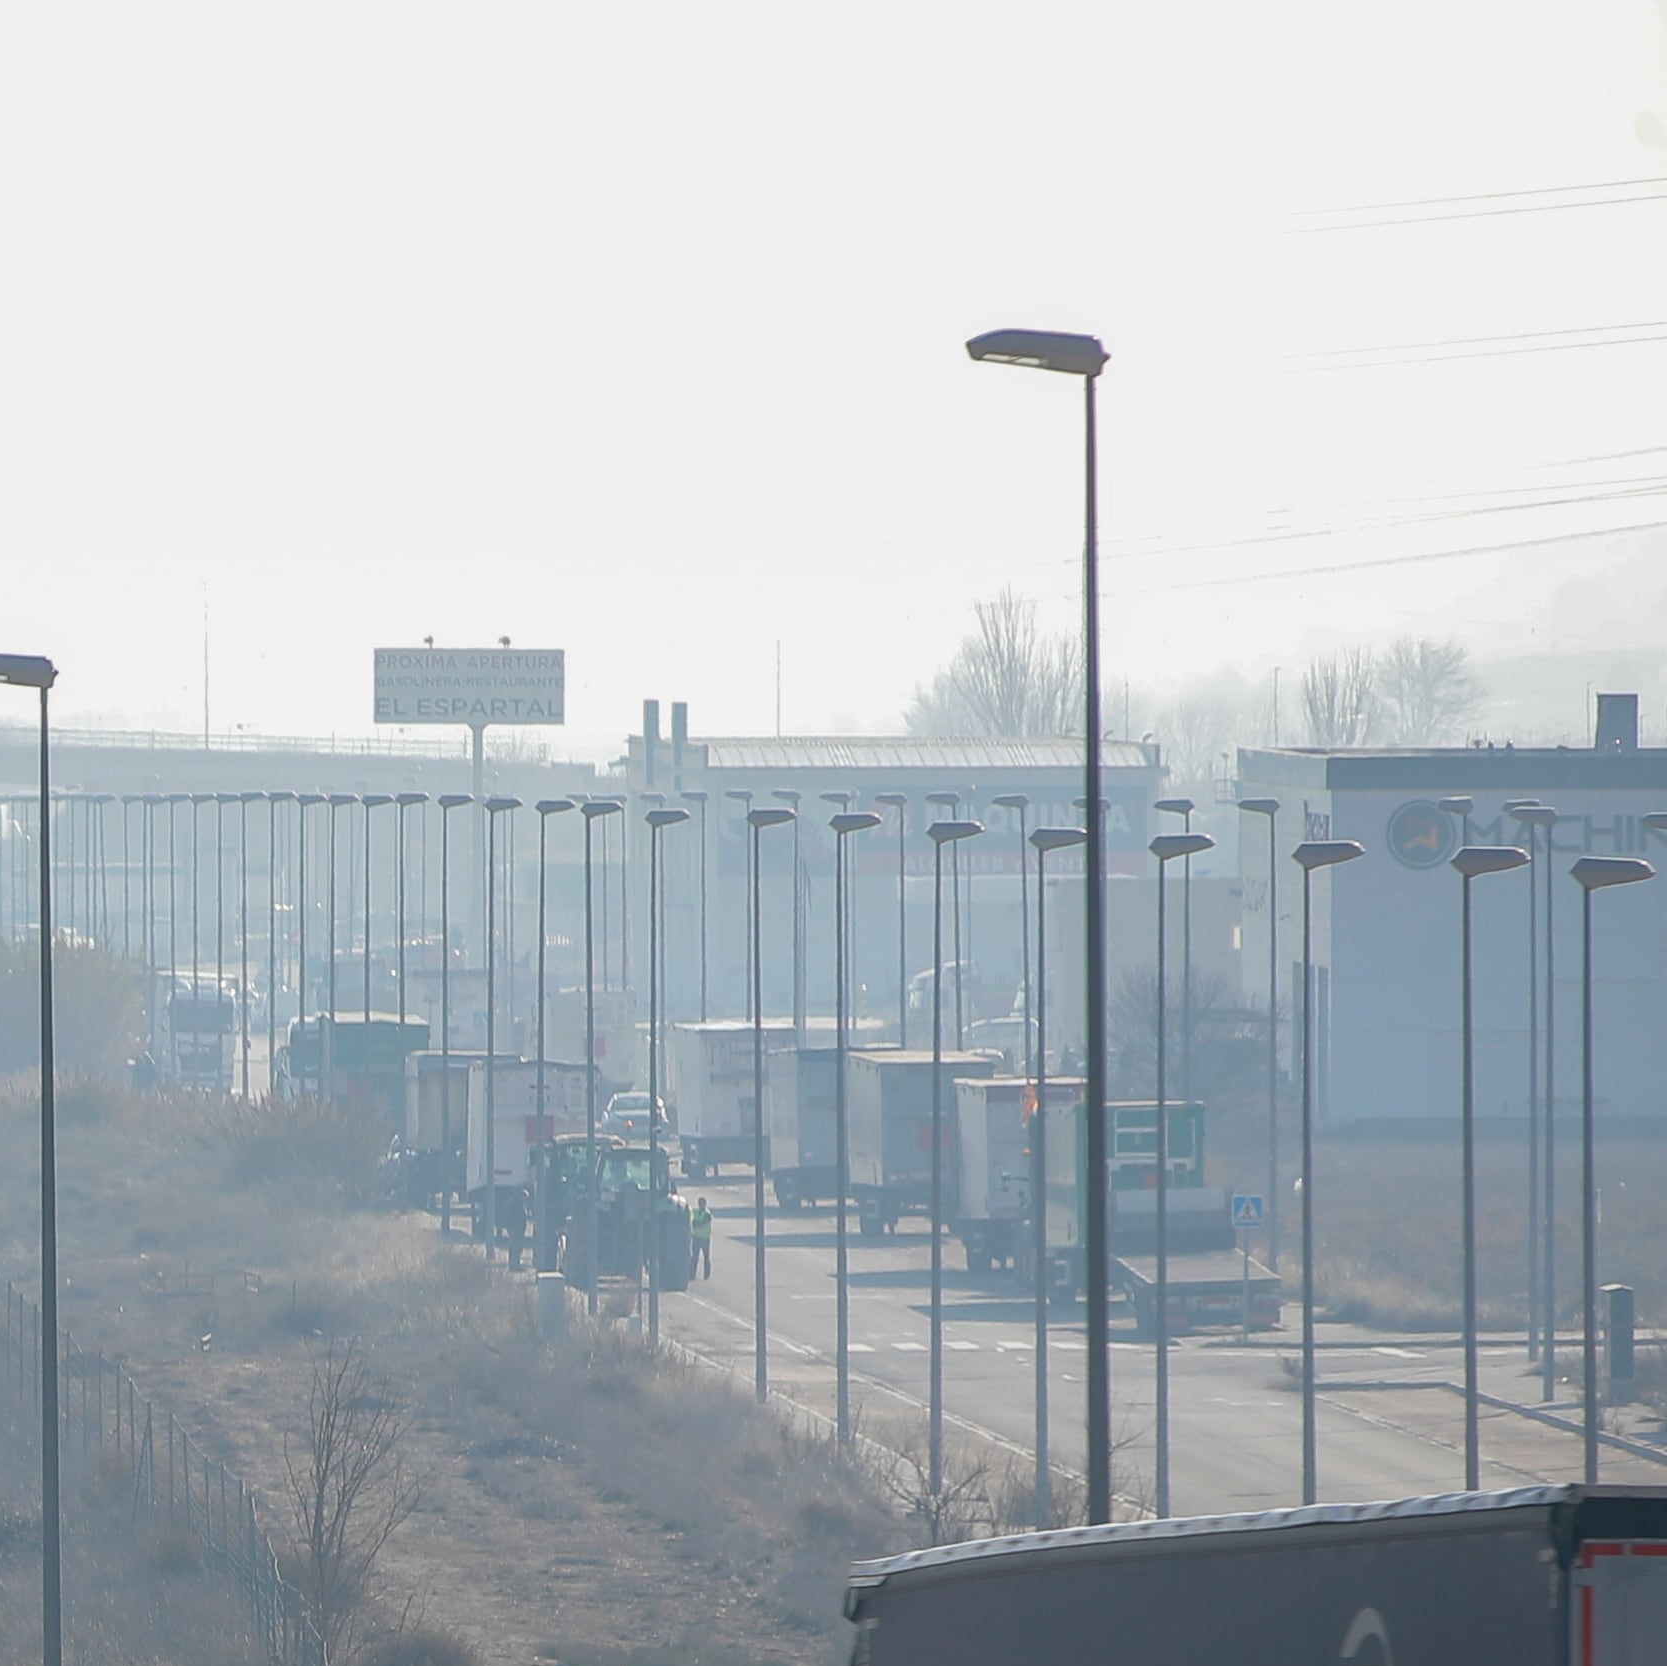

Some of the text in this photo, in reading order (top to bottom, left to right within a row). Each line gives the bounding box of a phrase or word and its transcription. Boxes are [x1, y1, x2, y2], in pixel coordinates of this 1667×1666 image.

[467, 655, 562, 670] APERTURA
[377, 699, 563, 718] EL ESPARTAL
